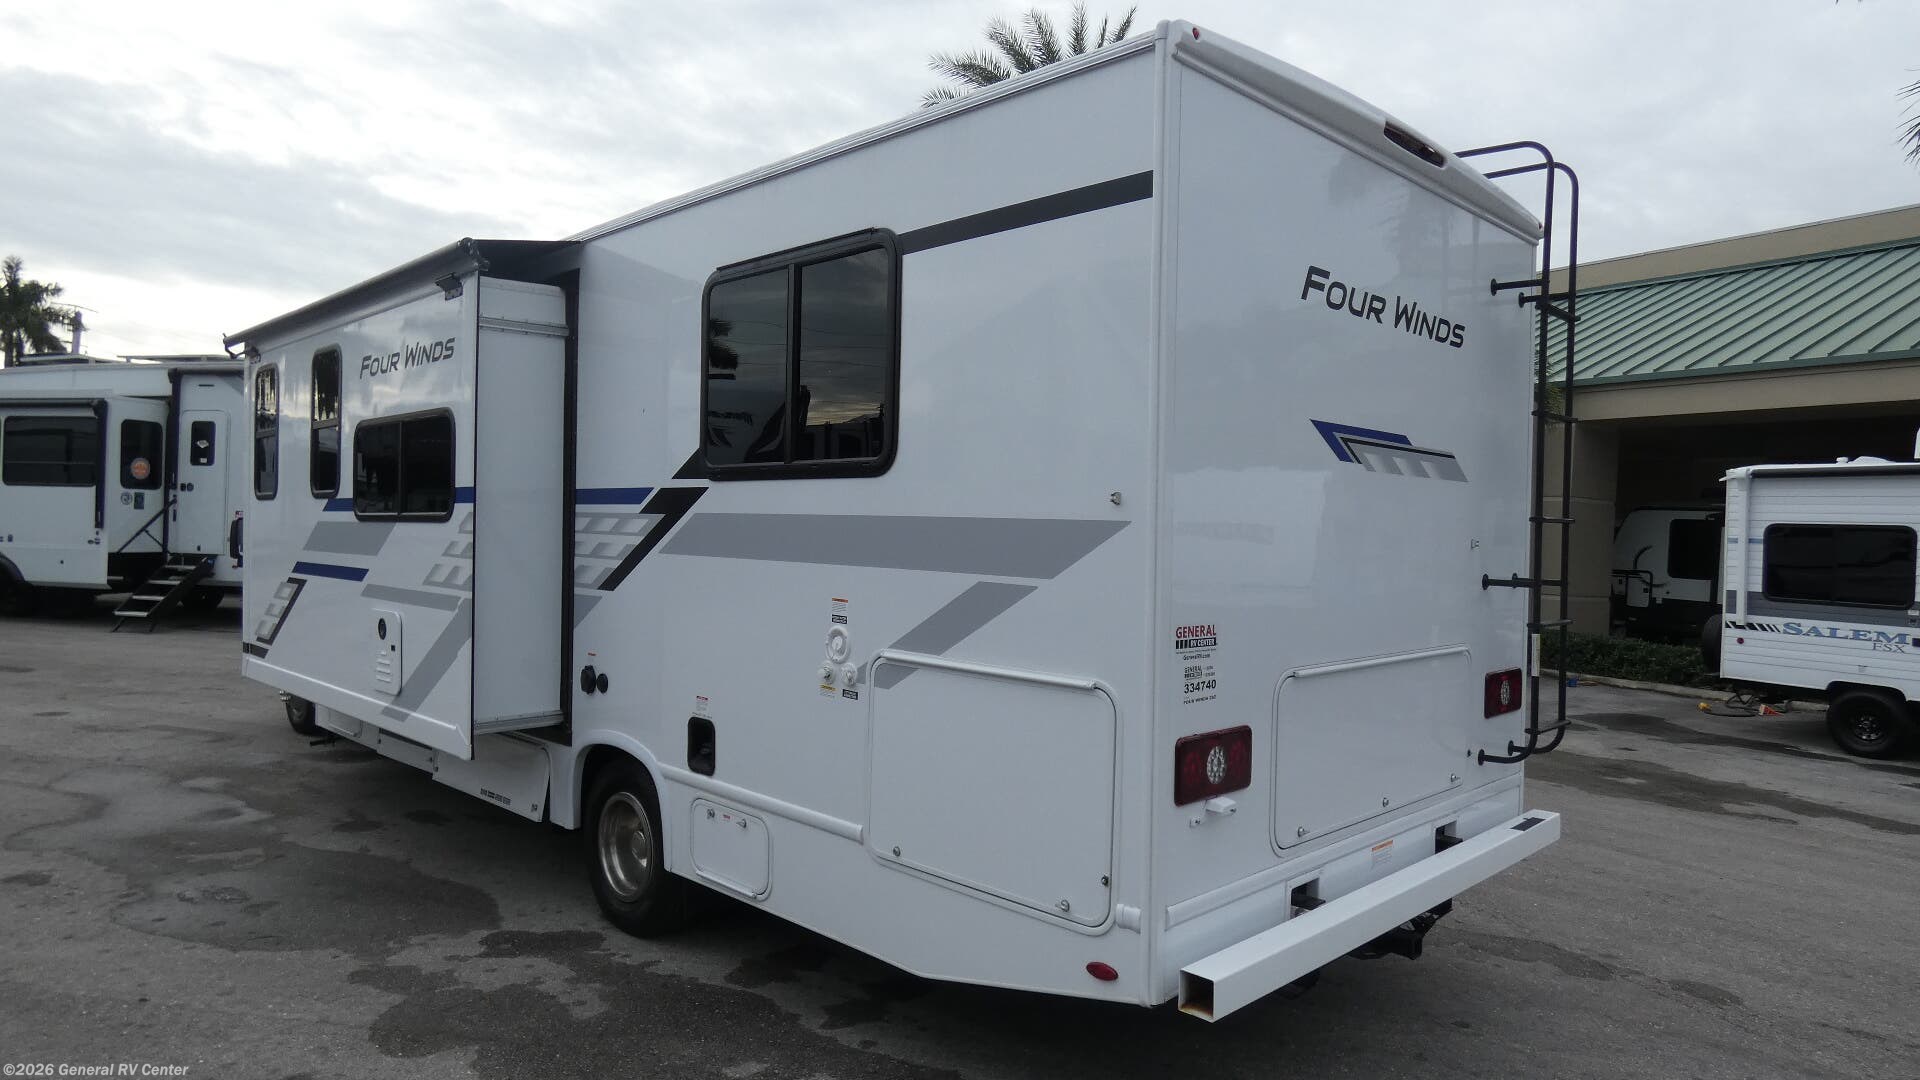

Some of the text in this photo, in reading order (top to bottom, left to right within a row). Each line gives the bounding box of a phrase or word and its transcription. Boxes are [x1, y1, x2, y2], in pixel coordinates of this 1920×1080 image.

[1301, 265, 1466, 348] FOUR WINDS
[360, 337, 456, 379] FOUR WINDS
[1176, 625, 1216, 639] GENERAL
[1782, 622, 1911, 646] SALEM
[1198, 638, 1215, 647] CENTER
[1184, 679, 1217, 694] 334740
